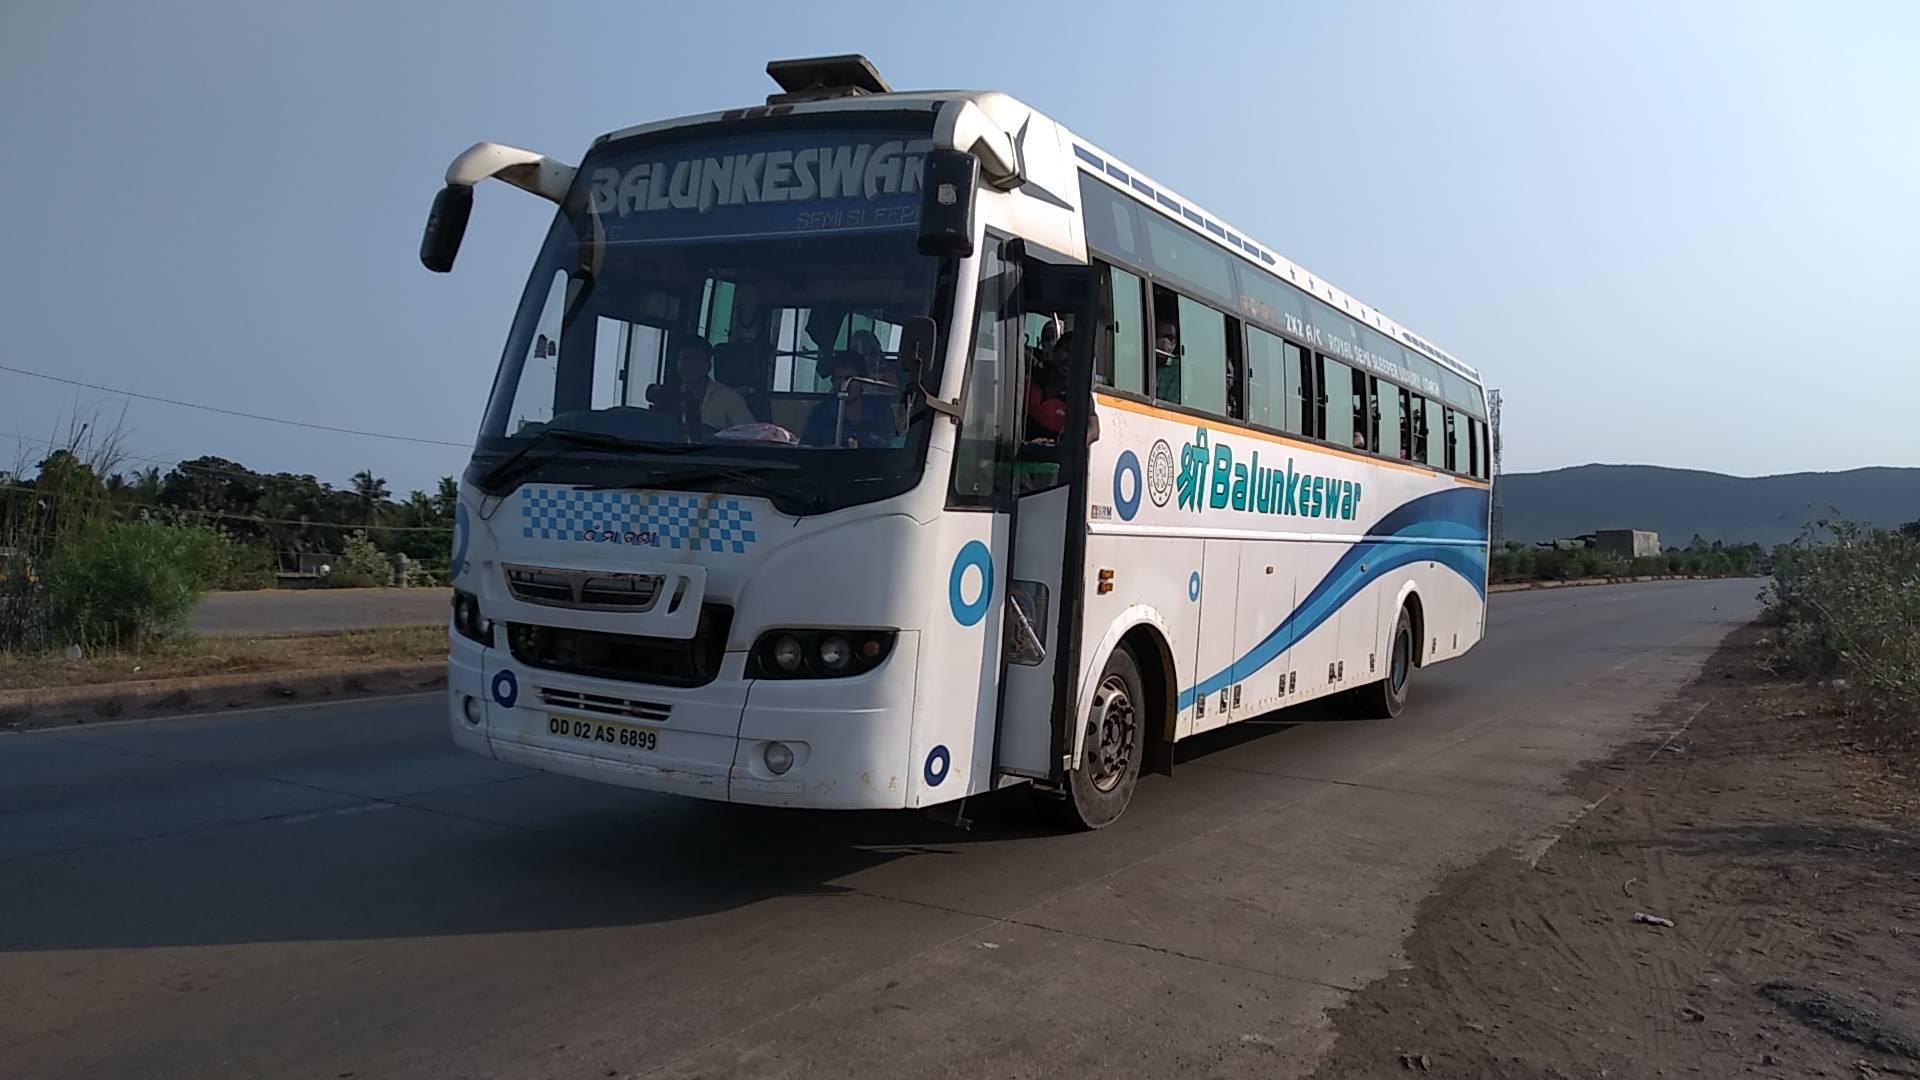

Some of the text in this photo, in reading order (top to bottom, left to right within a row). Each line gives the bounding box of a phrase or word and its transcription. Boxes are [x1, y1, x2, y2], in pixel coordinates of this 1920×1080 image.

[1284, 312, 1305, 338] 2X2
[1305, 323, 1323, 346] A/C
[1177, 426, 1210, 514] श्री
[1210, 443, 1362, 521] Balunkeswar
[550, 718, 657, 750] OD 02 AS 6899
